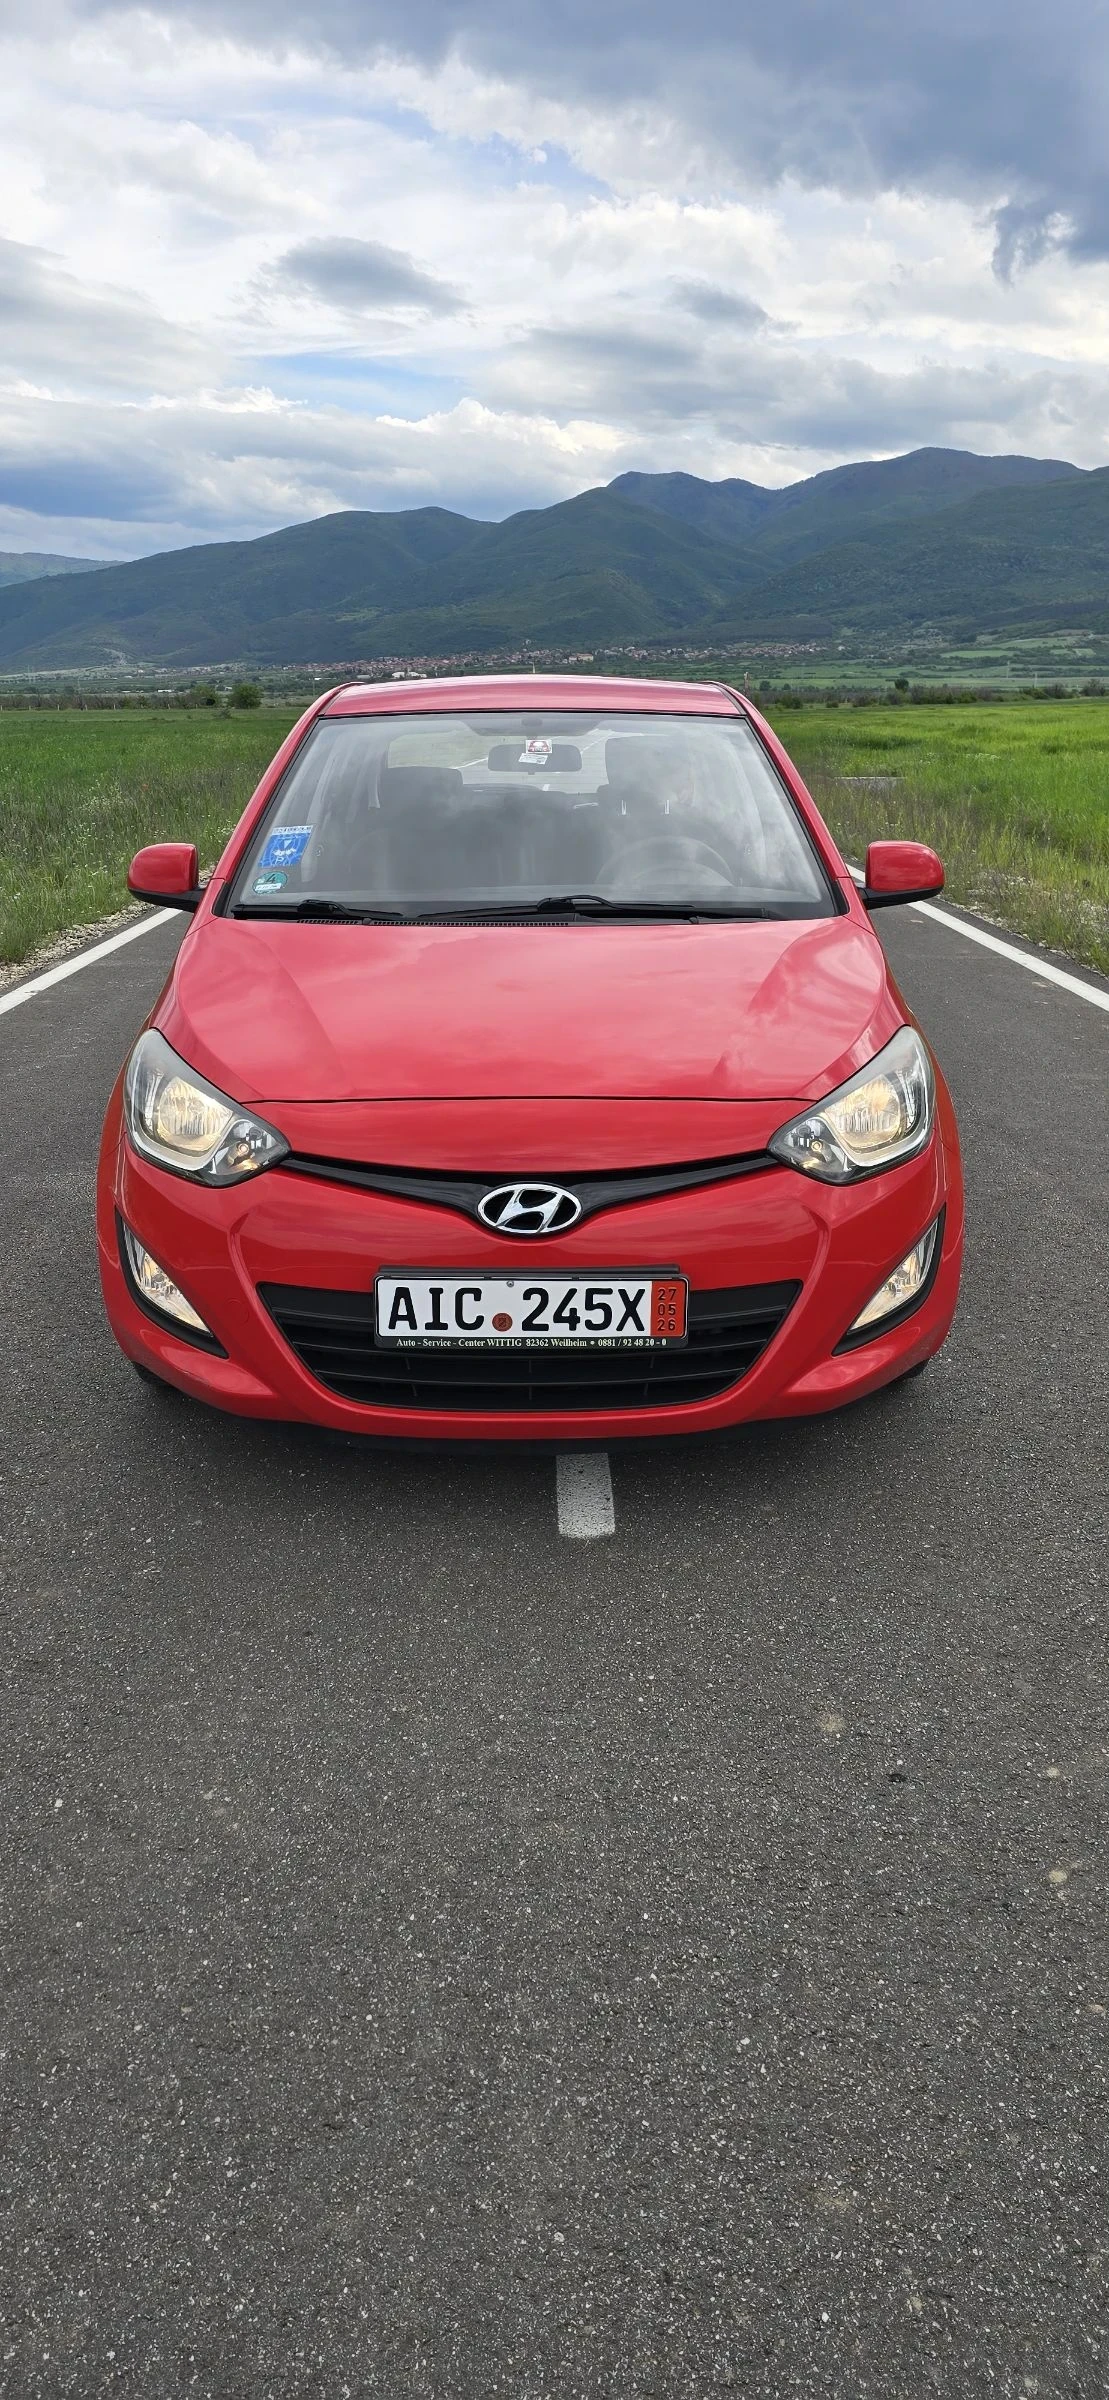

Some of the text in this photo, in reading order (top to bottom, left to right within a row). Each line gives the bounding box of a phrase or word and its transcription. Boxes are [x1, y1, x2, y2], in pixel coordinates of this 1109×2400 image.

[266, 873, 276, 884] 4
[657, 1286, 677, 1301] 27
[387, 1286, 646, 1332] AIC 245X
[657, 1302, 677, 1316] 05
[657, 1317, 677, 1331] 26
[396, 1338, 416, 1347] Auto
[422, 1338, 451, 1347] Service
[458, 1338, 485, 1347] Center
[486, 1338, 522, 1347] WITTIG
[525, 1338, 549, 1347] 82362
[551, 1338, 587, 1347] Weilheim
[597, 1338, 616, 1347] 0881
[622, 1338, 632, 1347] 92
[633, 1338, 644, 1347] 48
[645, 1338, 654, 1347] 20
[662, 1338, 667, 1347] 0
